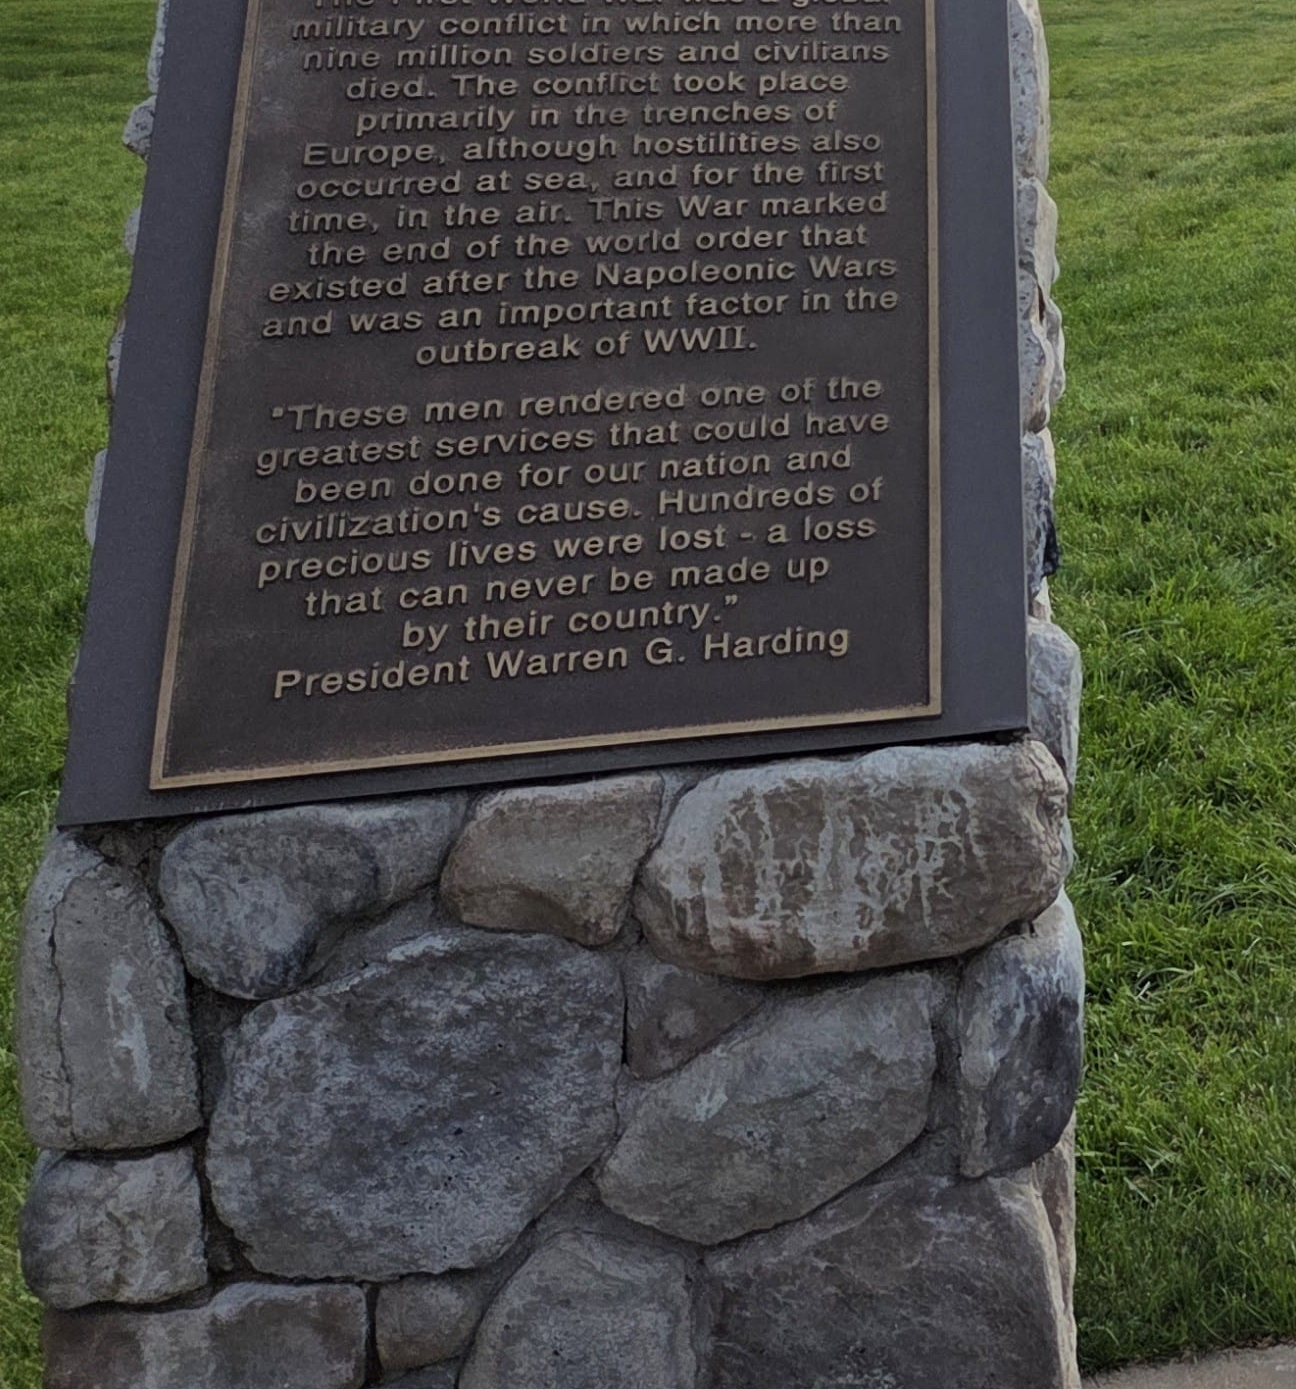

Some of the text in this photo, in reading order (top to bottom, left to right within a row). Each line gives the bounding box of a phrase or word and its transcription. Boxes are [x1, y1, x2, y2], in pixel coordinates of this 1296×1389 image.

[304, 39, 890, 67] nine million soldiers and civilians
[346, 69, 851, 98] died. The conflict took place
[304, 129, 884, 167] Europe, although hostilities also
[289, 190, 889, 232] time, in the air. This War marked
[269, 254, 898, 300] existed after the Napoleonic Wars
[416, 325, 757, 365] outbreak of WWII.
[424, 398, 505, 422] men
[520, 383, 688, 416] rendered
[700, 384, 770, 406] one
[780, 376, 817, 402] of
[827, 376, 884, 400] the
[257, 411, 890, 474] greatest services that could have
[256, 475, 884, 542] civilization's cause. Hundreds of
[306, 556, 831, 616] that can never be made up
[402, 619, 450, 652] by
[464, 609, 554, 642] their
[274, 626, 850, 697] President Warren G. Harding
